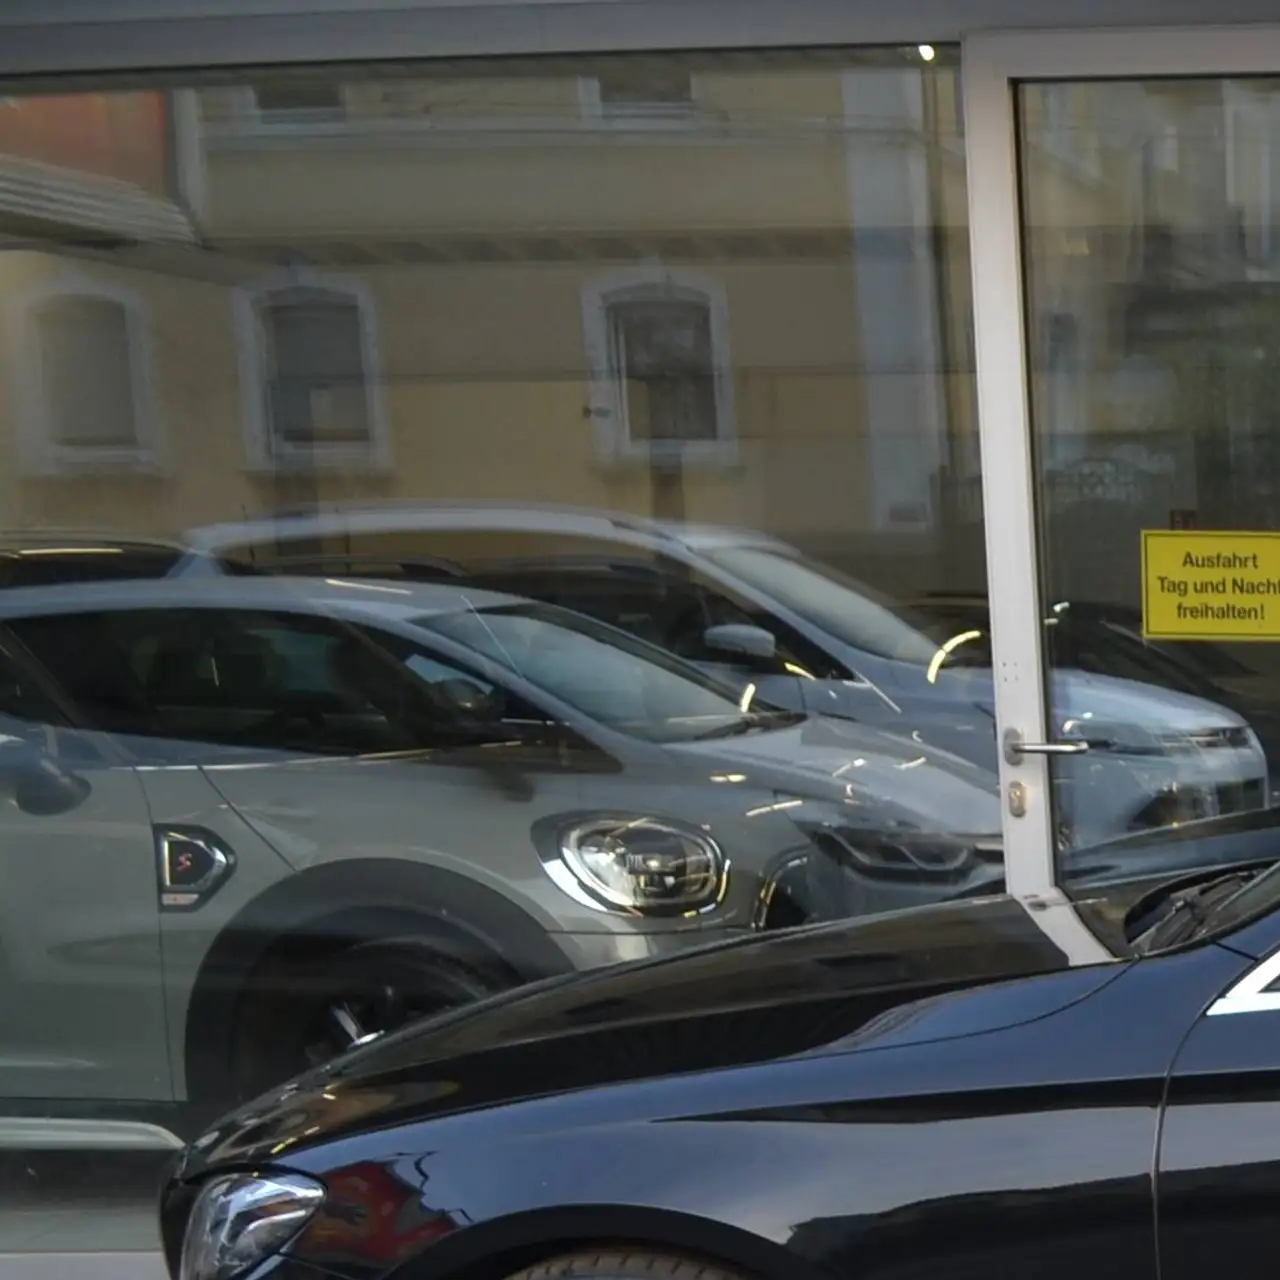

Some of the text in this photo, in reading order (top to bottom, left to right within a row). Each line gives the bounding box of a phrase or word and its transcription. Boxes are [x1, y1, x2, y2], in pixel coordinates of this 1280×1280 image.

[1181, 551, 1259, 569] Ausfahrt
[1157, 576, 1188, 596] Tag
[1193, 577, 1227, 594] und
[1176, 602, 1265, 620] freihalten!
